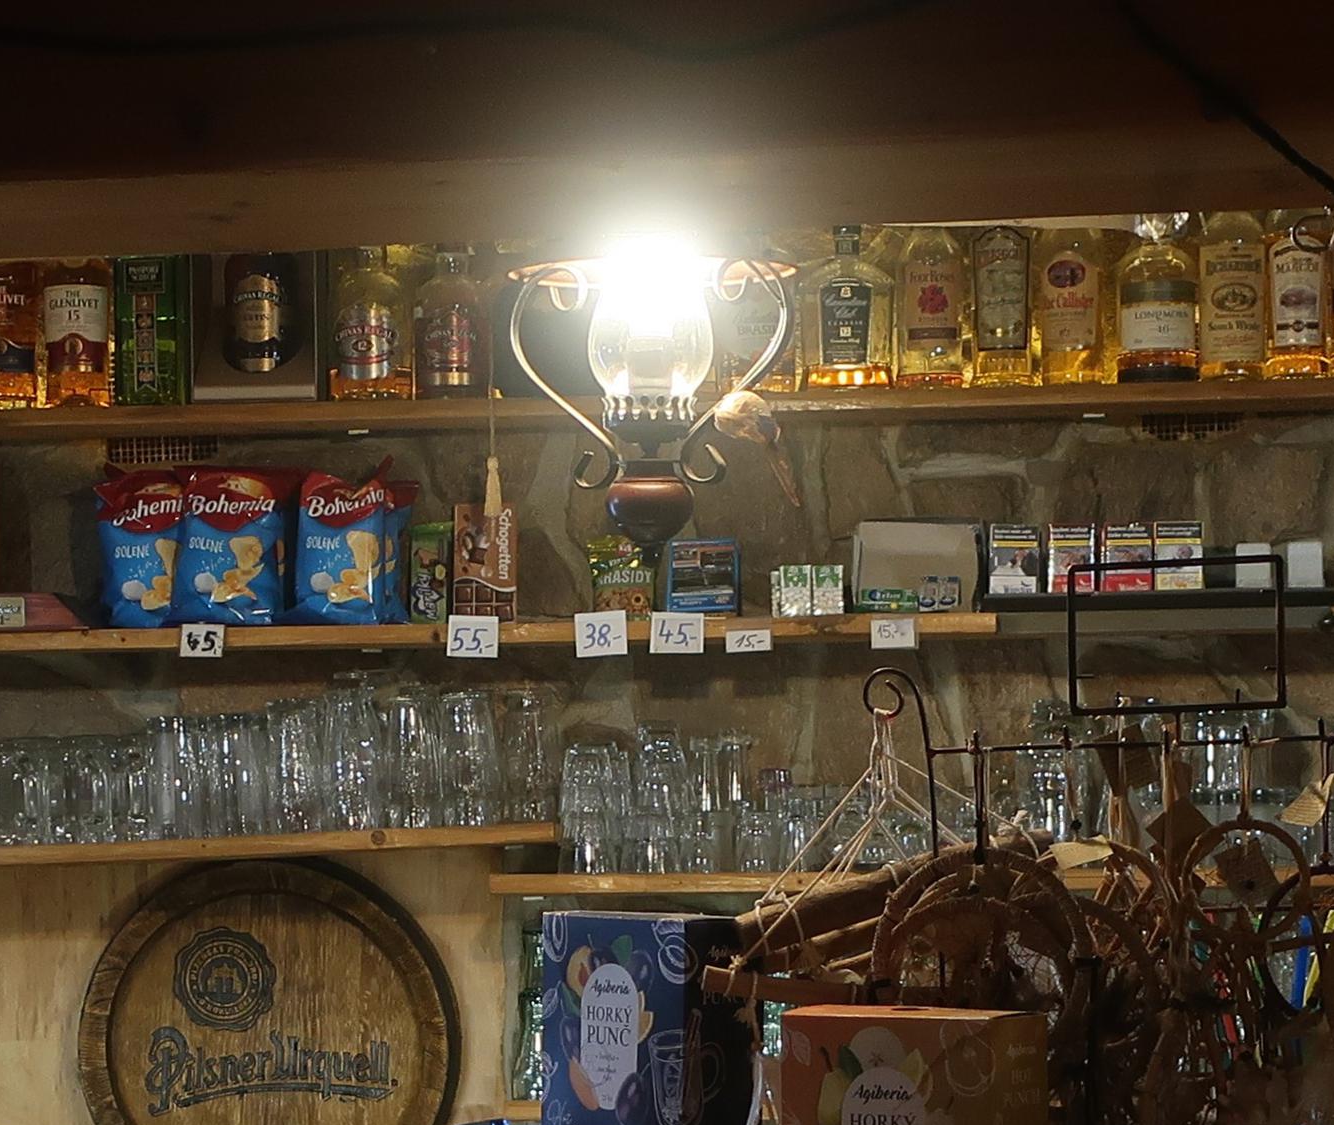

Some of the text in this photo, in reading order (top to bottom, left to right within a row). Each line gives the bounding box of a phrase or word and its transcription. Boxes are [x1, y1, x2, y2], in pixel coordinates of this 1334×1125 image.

[49, 298, 99, 310] GLENLIVET
[65, 290, 81, 298] THE
[68, 309, 80, 321] 15
[187, 493, 276, 516] Bohemia
[306, 487, 386, 518] Bohemia
[114, 542, 150, 559] SOLENÉ
[189, 533, 224, 553] SOLENÉ
[306, 533, 341, 550] SOLENÉ
[497, 507, 513, 581] Schogetten
[583, 622, 622, 649] 38,-
[658, 620, 698, 647] 45,-
[586, 1003, 633, 1024] HORKÝ
[587, 1024, 631, 1047] PUNČ
[145, 1026, 391, 1117] Pilsner Urquell
[853, 1084, 913, 1105] Agiberia
